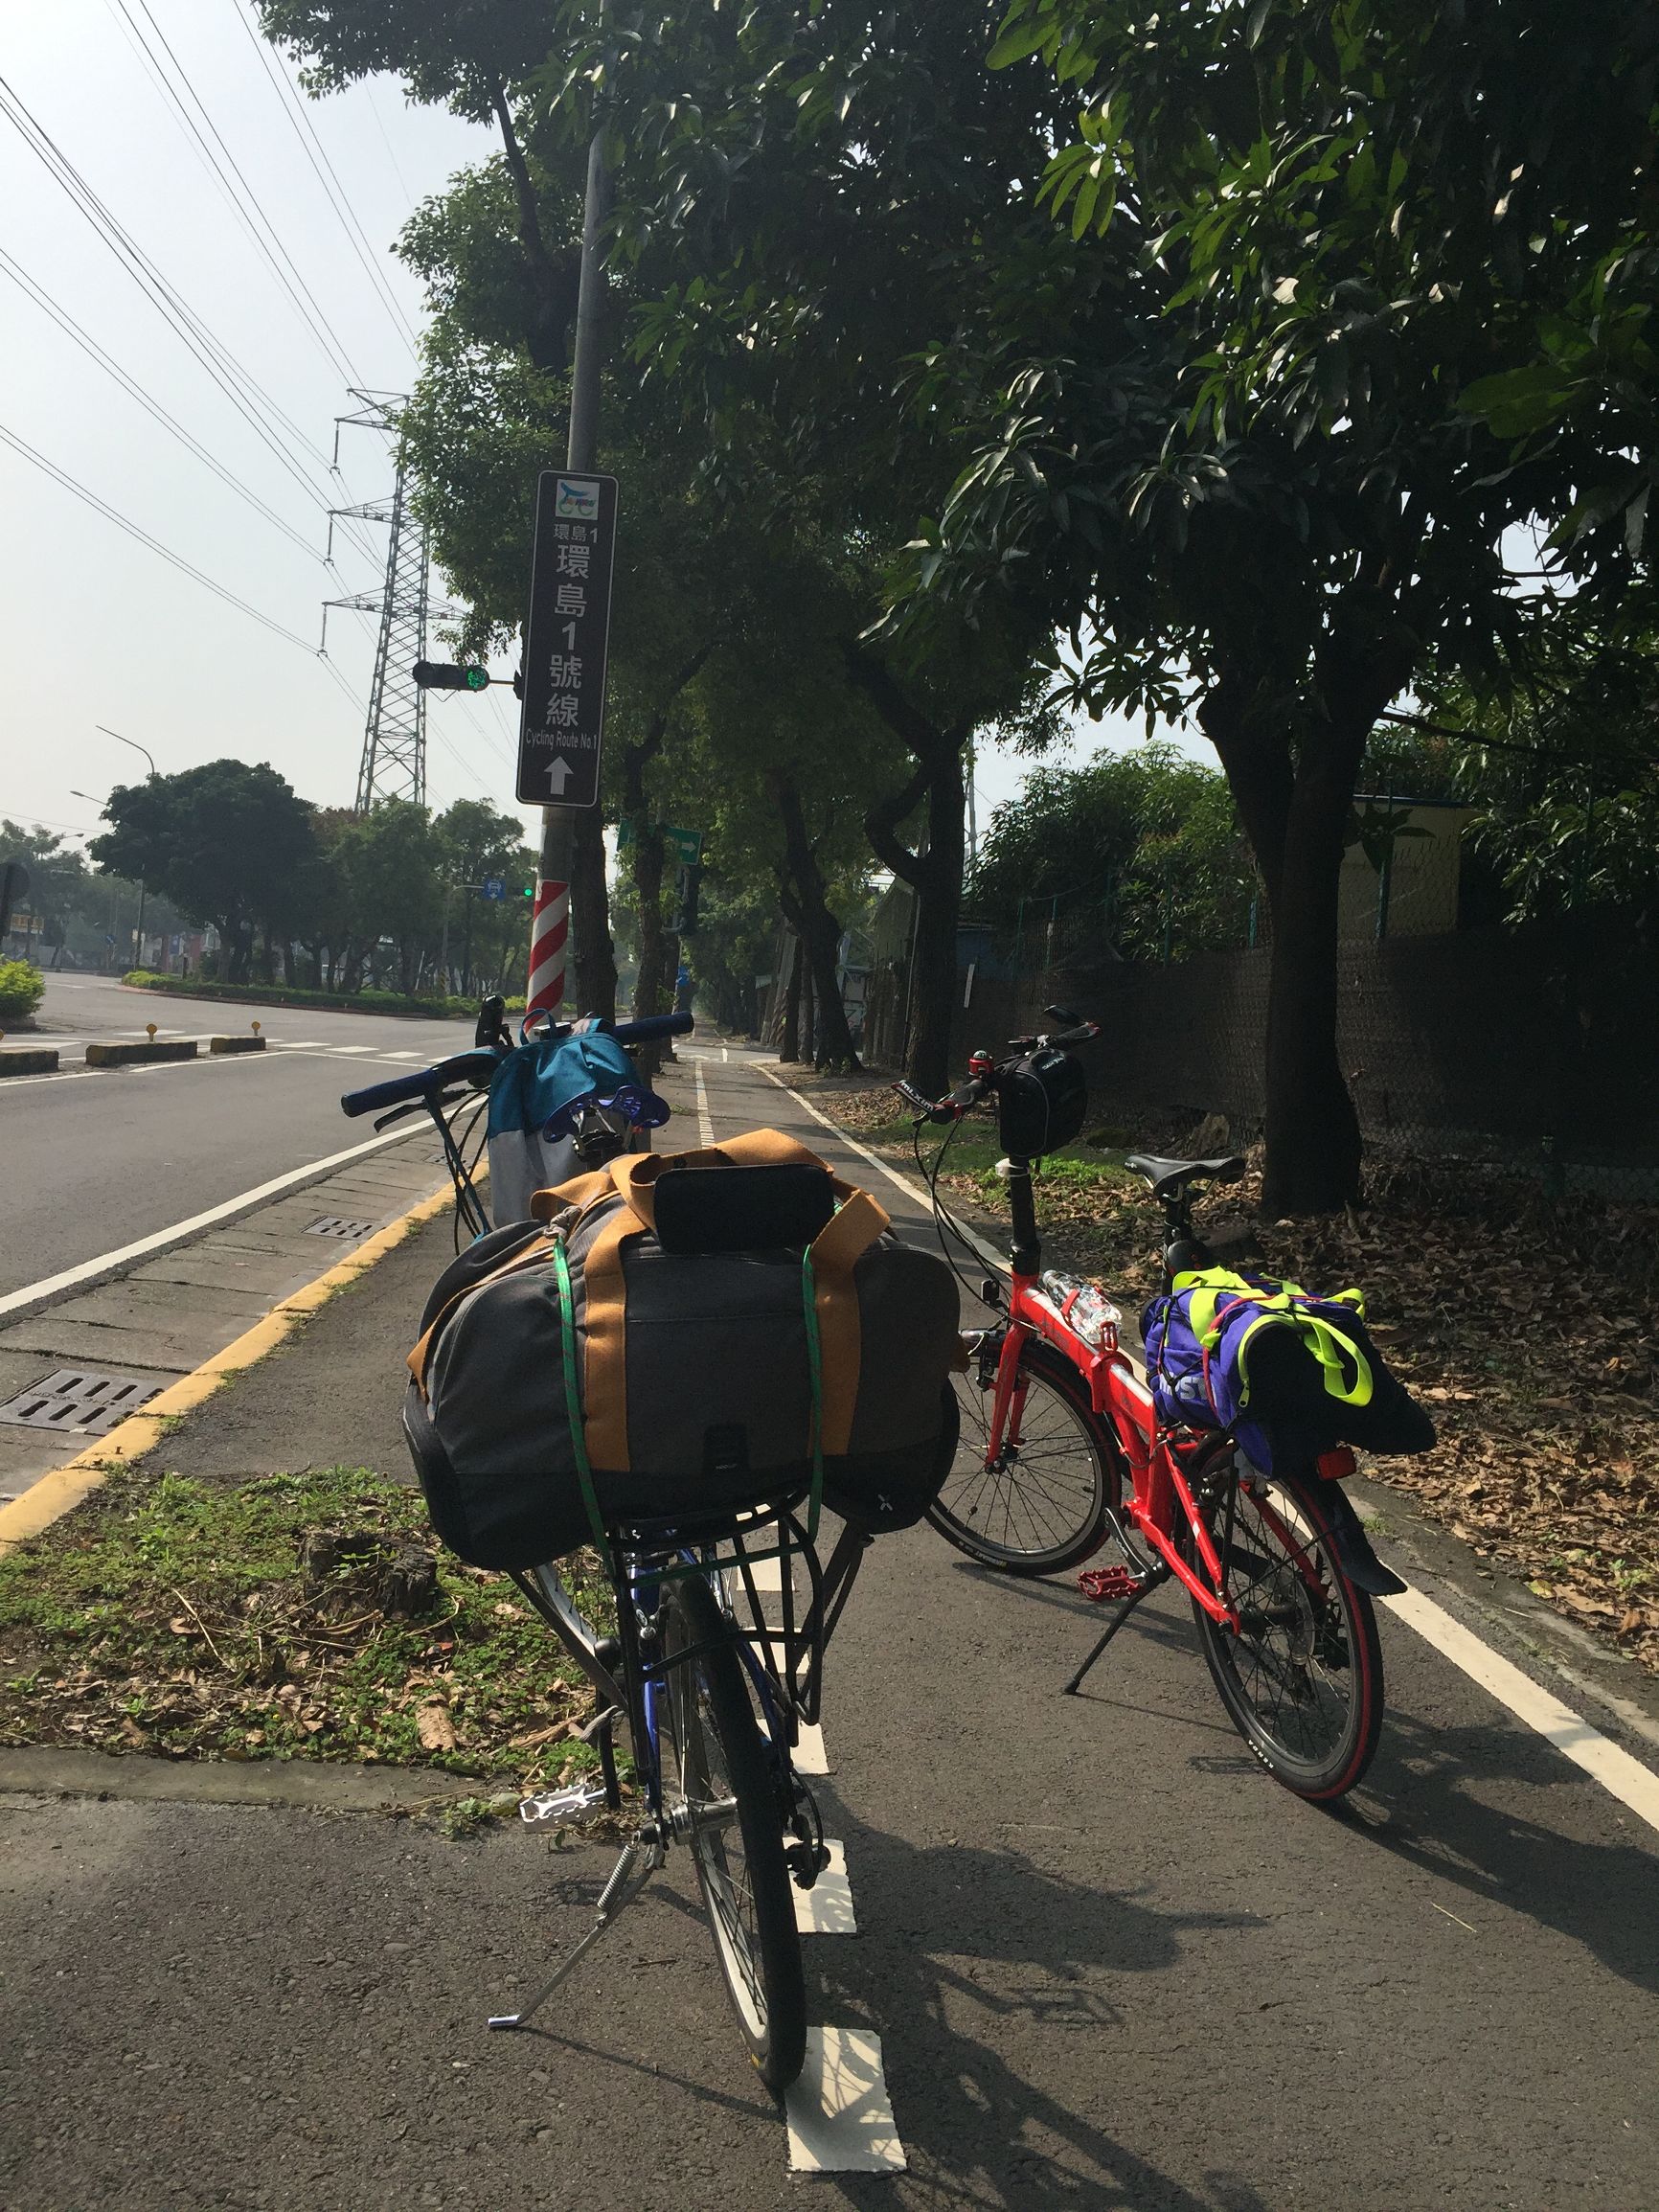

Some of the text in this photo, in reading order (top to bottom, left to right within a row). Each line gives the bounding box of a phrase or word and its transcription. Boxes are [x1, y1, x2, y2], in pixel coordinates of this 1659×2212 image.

[553, 523, 599, 543] 環島1
[546, 544, 590, 727] 環島1號線
[526, 728, 555, 751] Cycling
[556, 730, 579, 748] Route
[1248, 1739, 1274, 1768] KENDA
